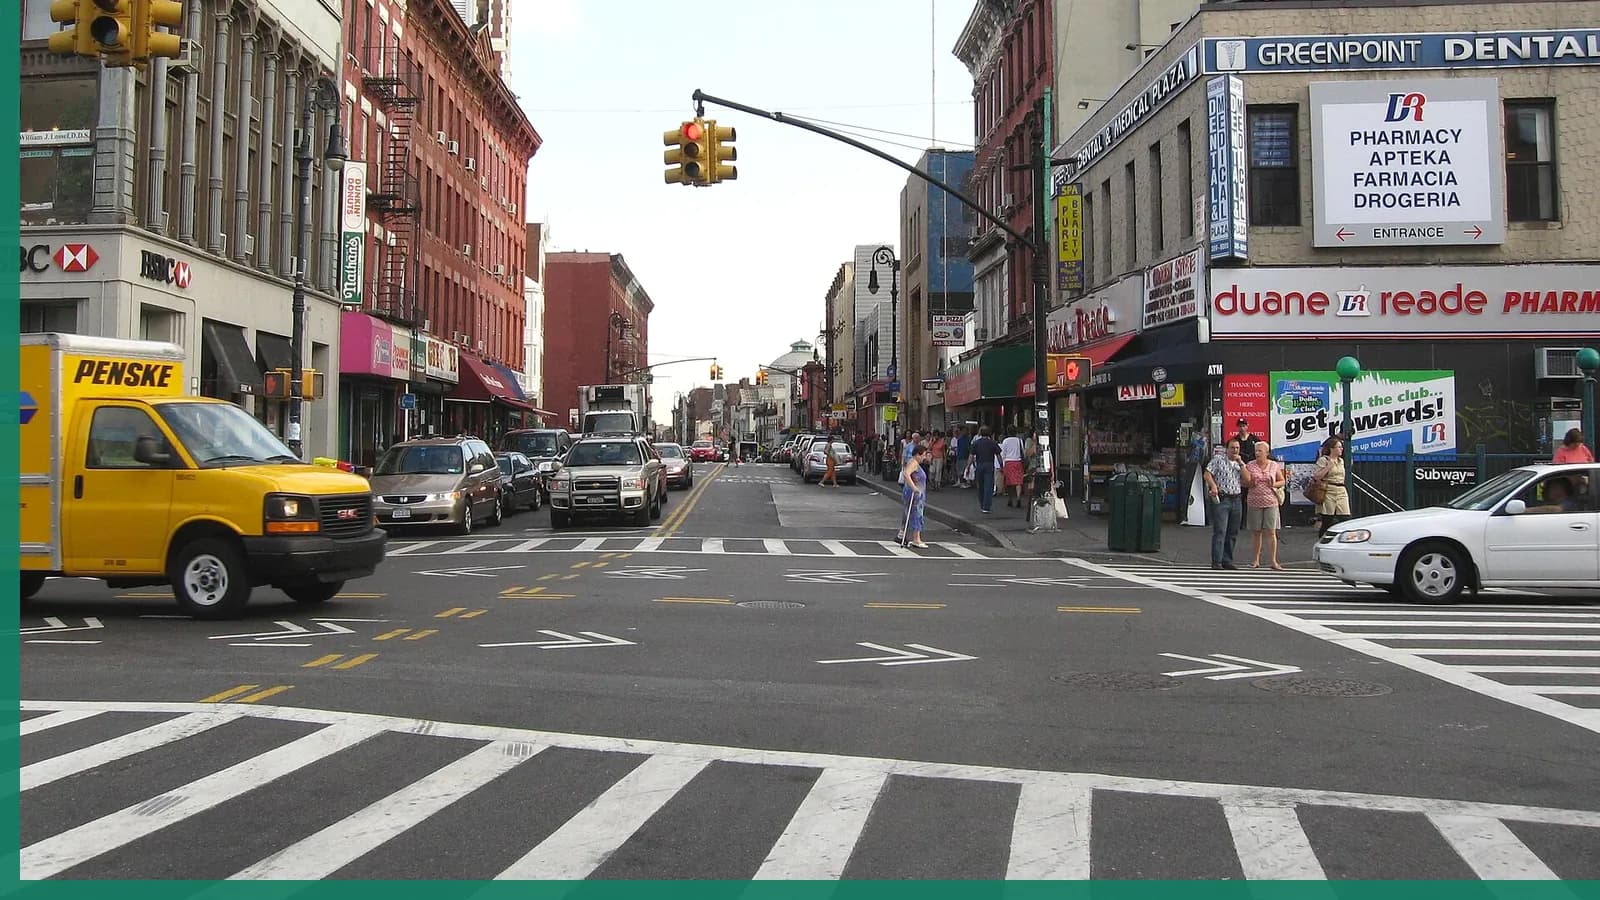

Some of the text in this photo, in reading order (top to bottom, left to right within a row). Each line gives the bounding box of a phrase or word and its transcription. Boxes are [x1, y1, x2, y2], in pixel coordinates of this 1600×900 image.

[1258, 34, 1600, 66] GREENPOINT DENTAL
[1077, 61, 1186, 170] DENTAL & MEDICAL PLAZA
[1384, 92, 1426, 122] DR
[1350, 129, 1462, 146] PHARMACY
[1369, 150, 1452, 166] APTEKA
[1353, 171, 1458, 187] FARMACIA
[346, 178, 354, 215] DONUTS
[1062, 185, 1079, 195] SPA
[1354, 192, 1461, 208] DROGERIA
[1373, 227, 1444, 238] ENTRANCE
[140, 250, 175, 284] HSBC
[343, 237, 359, 299] Nathan's
[1214, 284, 1330, 316] duane
[1381, 282, 1487, 315] reade
[74, 359, 174, 388] PENSKE
[1208, 364, 1223, 376] ATM
[1120, 384, 1156, 397] ATM
[1368, 395, 1393, 409] the
[1397, 386, 1443, 402] club...
[1285, 407, 1328, 440] get
[1360, 443, 1369, 451] up
[1370, 437, 1393, 448] today!
[1415, 468, 1467, 483] Subway
